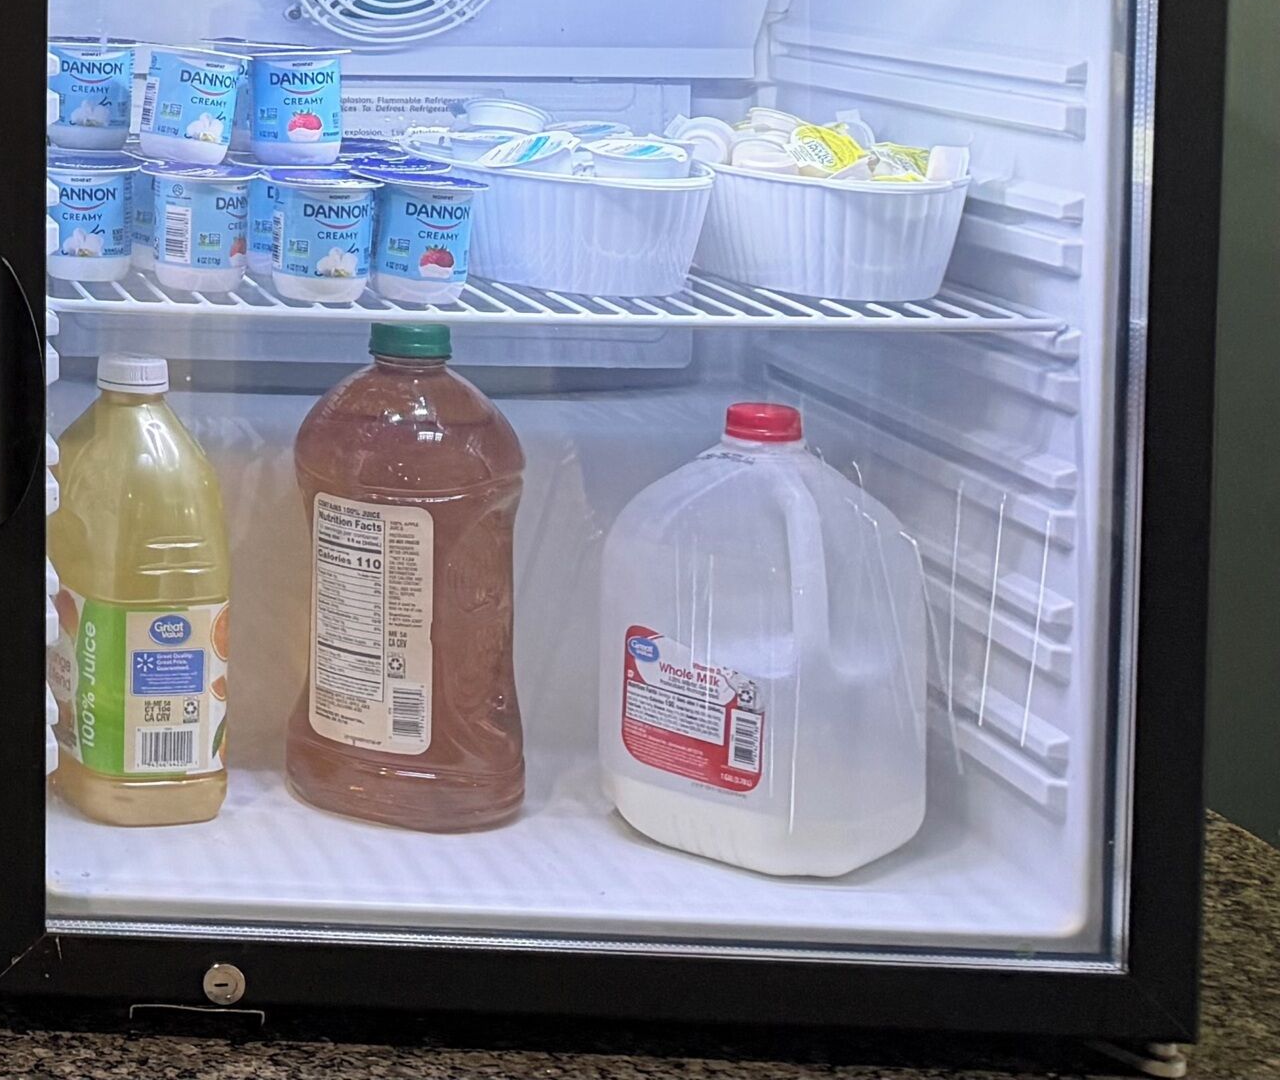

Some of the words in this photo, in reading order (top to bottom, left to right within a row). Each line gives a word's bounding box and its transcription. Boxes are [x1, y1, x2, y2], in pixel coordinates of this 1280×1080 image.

[61, 60, 122, 75] DANNON
[180, 69, 239, 89] DANNON
[269, 71, 334, 86] DANNON
[71, 85, 110, 94] CREAMY
[190, 96, 227, 108] CREAMY
[283, 97, 324, 106] CREAMY
[377, 96, 421, 105] Flammable
[375, 105, 406, 113] Defrost
[60, 187, 117, 201] ANNON
[62, 212, 102, 221] CREAMY
[303, 203, 369, 219] DANNON
[405, 202, 470, 220] DANNON
[317, 231, 358, 240] CREAMY
[418, 230, 459, 241] CREAMY
[319, 510, 352, 527] Nutrition
[355, 520, 382, 532] Facts
[318, 549, 352, 566] Calories
[357, 557, 382, 570] 110
[154, 622, 184, 633] Great
[82, 621, 96, 686] Juice
[659, 662, 693, 680] Whole
[697, 672, 720, 687] Mlk
[80, 692, 96, 748] 100%
